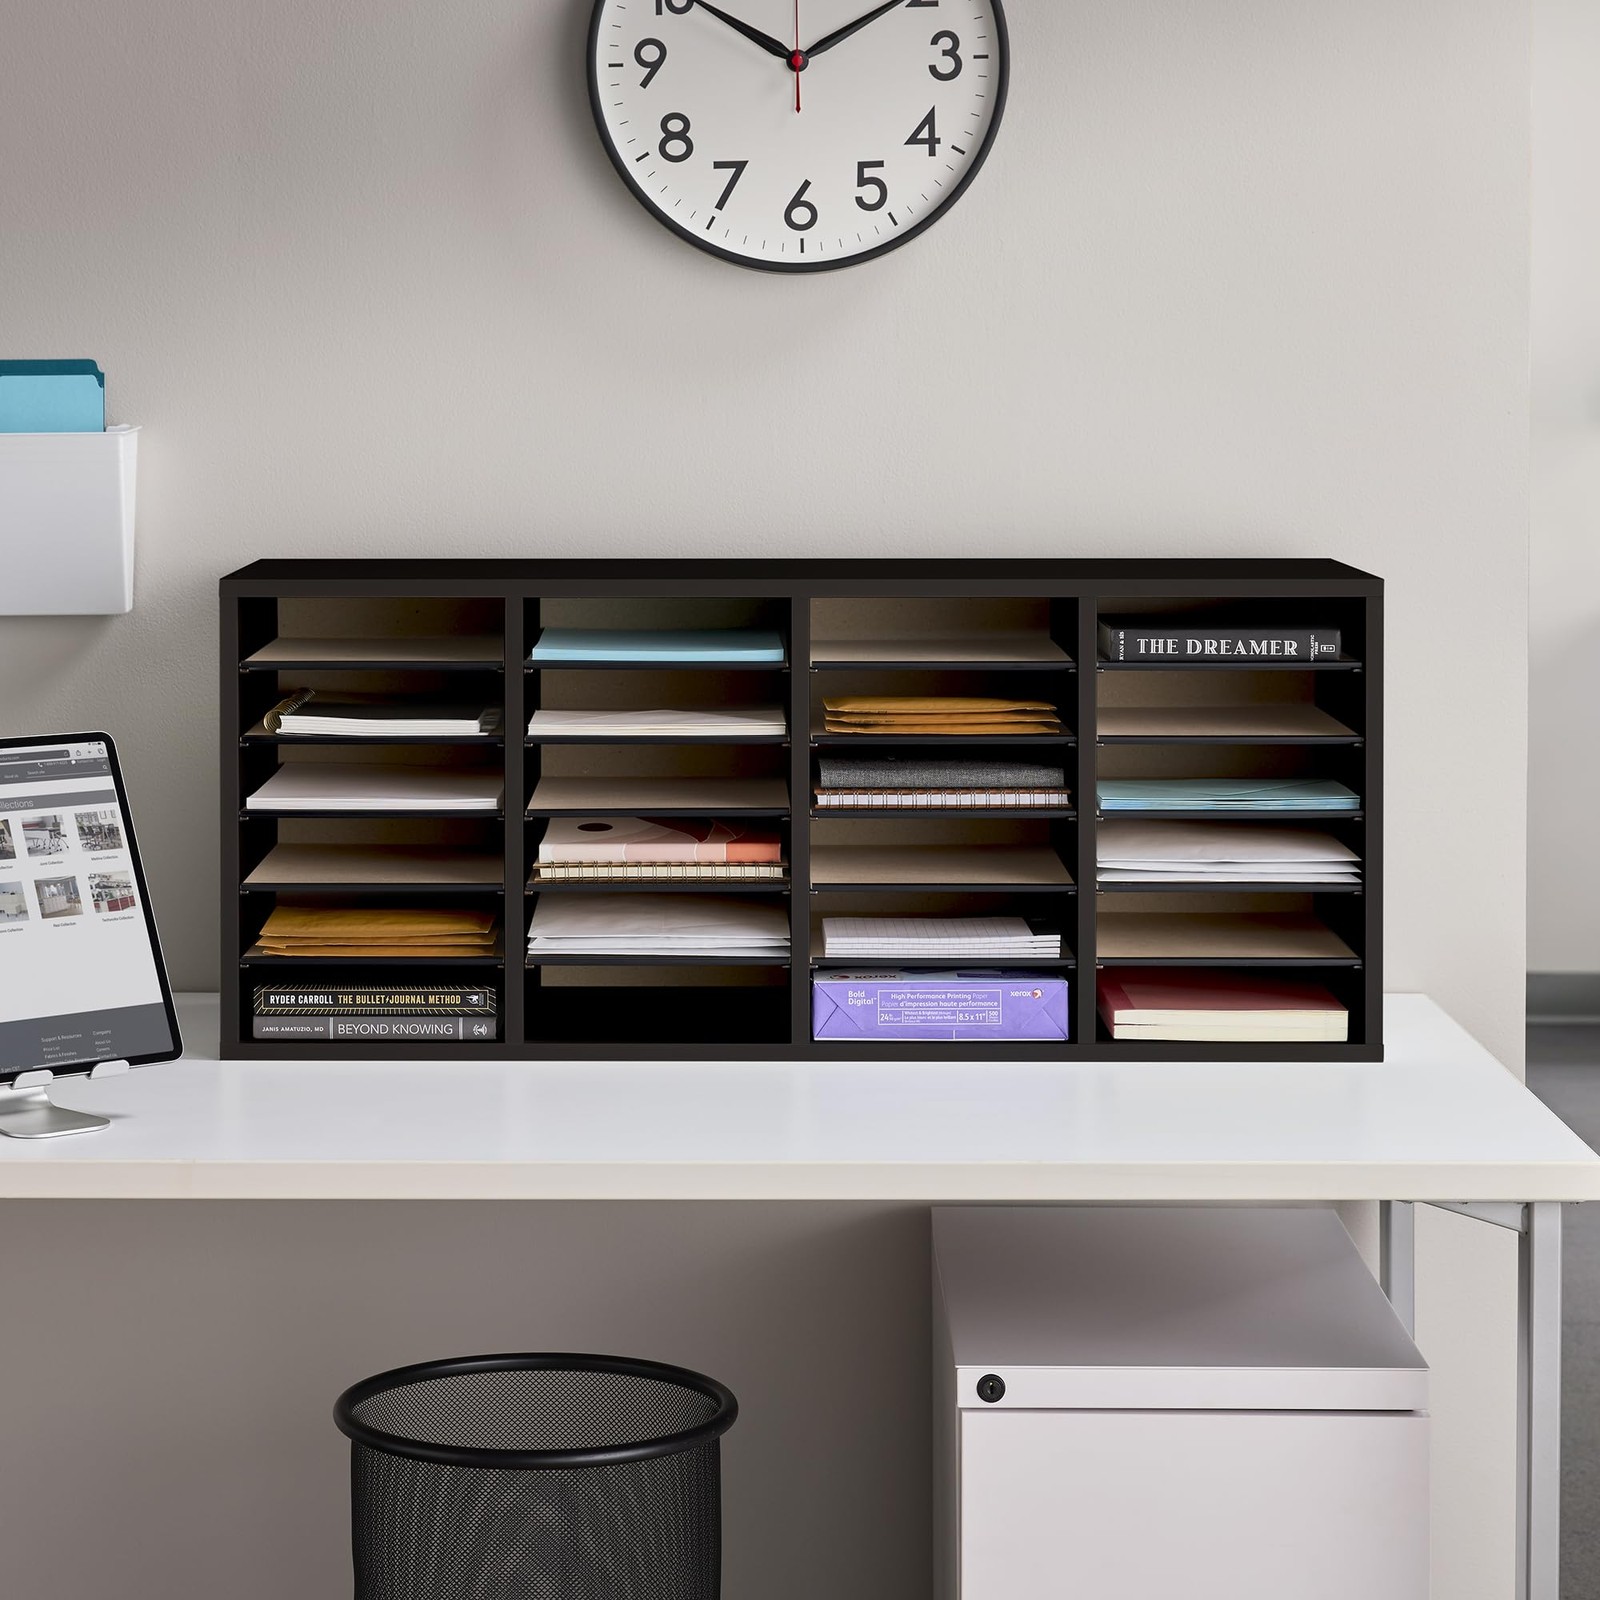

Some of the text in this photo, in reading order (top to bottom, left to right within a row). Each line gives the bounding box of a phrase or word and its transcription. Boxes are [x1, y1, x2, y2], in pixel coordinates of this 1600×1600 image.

[634, 38, 667, 89] 9
[929, 30, 962, 81] 3
[658, 112, 694, 163] 8
[904, 105, 941, 157] 4
[713, 160, 749, 211] 7
[784, 179, 818, 231] 6
[855, 160, 888, 211] 5
[1137, 638, 1298, 656] THE DREAMER
[270, 994, 296, 1004] RYDER
[298, 994, 334, 1004] CARROLL
[338, 994, 354, 1004] THE
[428, 994, 461, 1004] METHOD
[880, 1013, 889, 1021] 24
[946, 992, 972, 1000] Printing
[972, 992, 988, 1000] Paper
[958, 1013, 970, 1021] 8.5
[338, 1024, 454, 1035] BEYOND KNOWING
